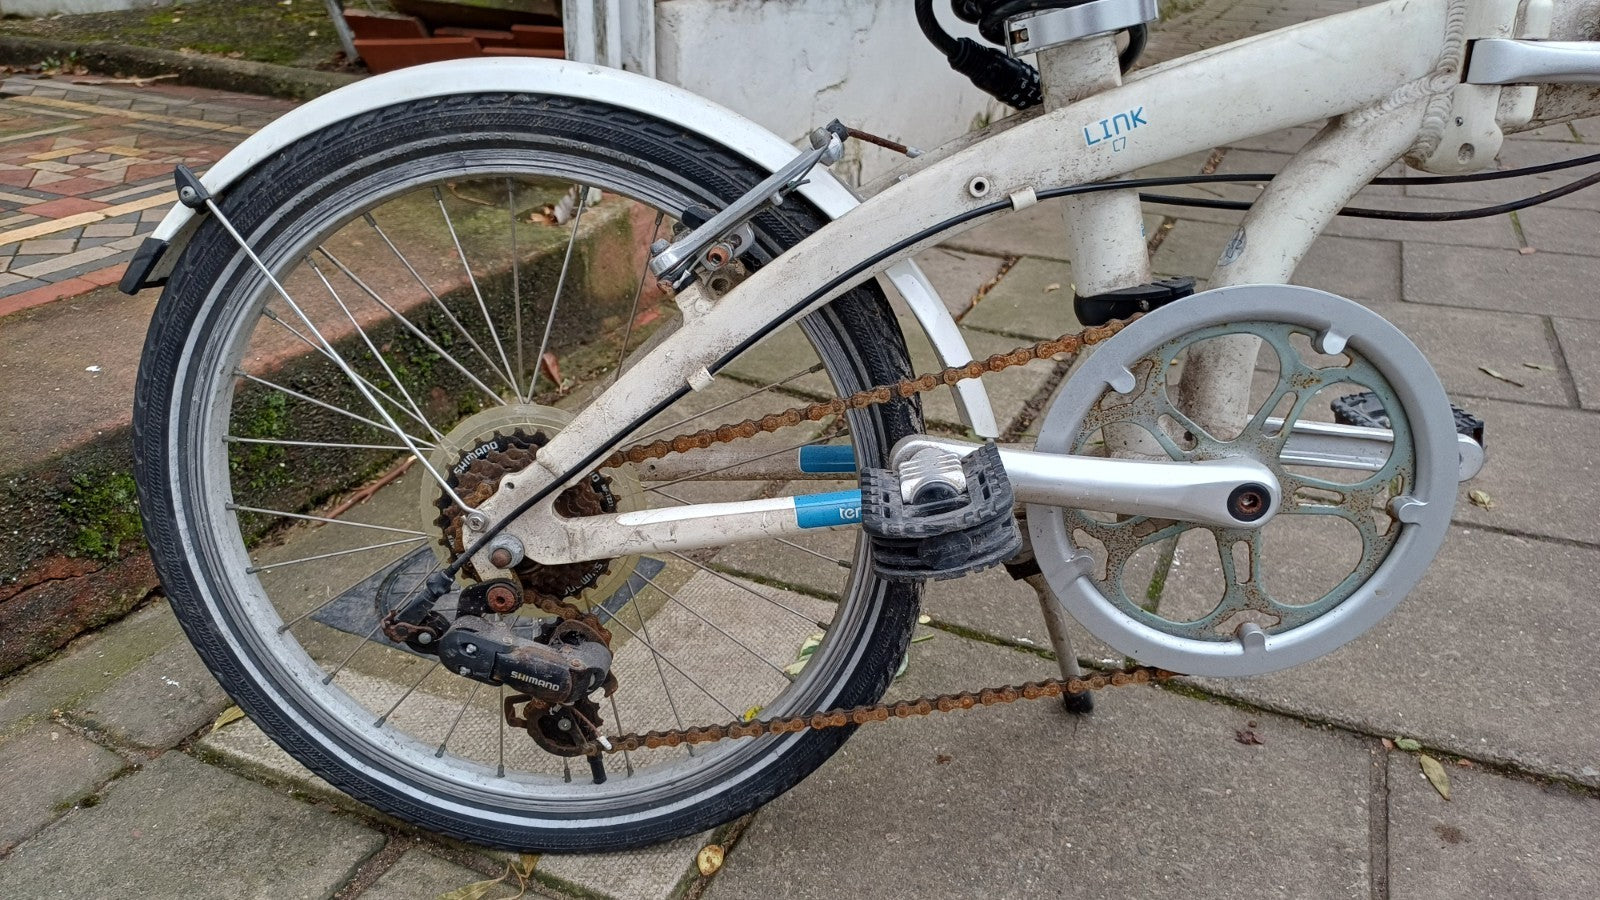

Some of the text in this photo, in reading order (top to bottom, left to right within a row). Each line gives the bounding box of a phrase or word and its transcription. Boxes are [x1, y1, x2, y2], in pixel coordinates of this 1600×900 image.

[1084, 107, 1147, 145] LINK
[1112, 136, 1126, 152] C7
[453, 441, 498, 474] SHIMANO
[839, 505, 862, 519] ter
[510, 670, 560, 692] SHIMANO
